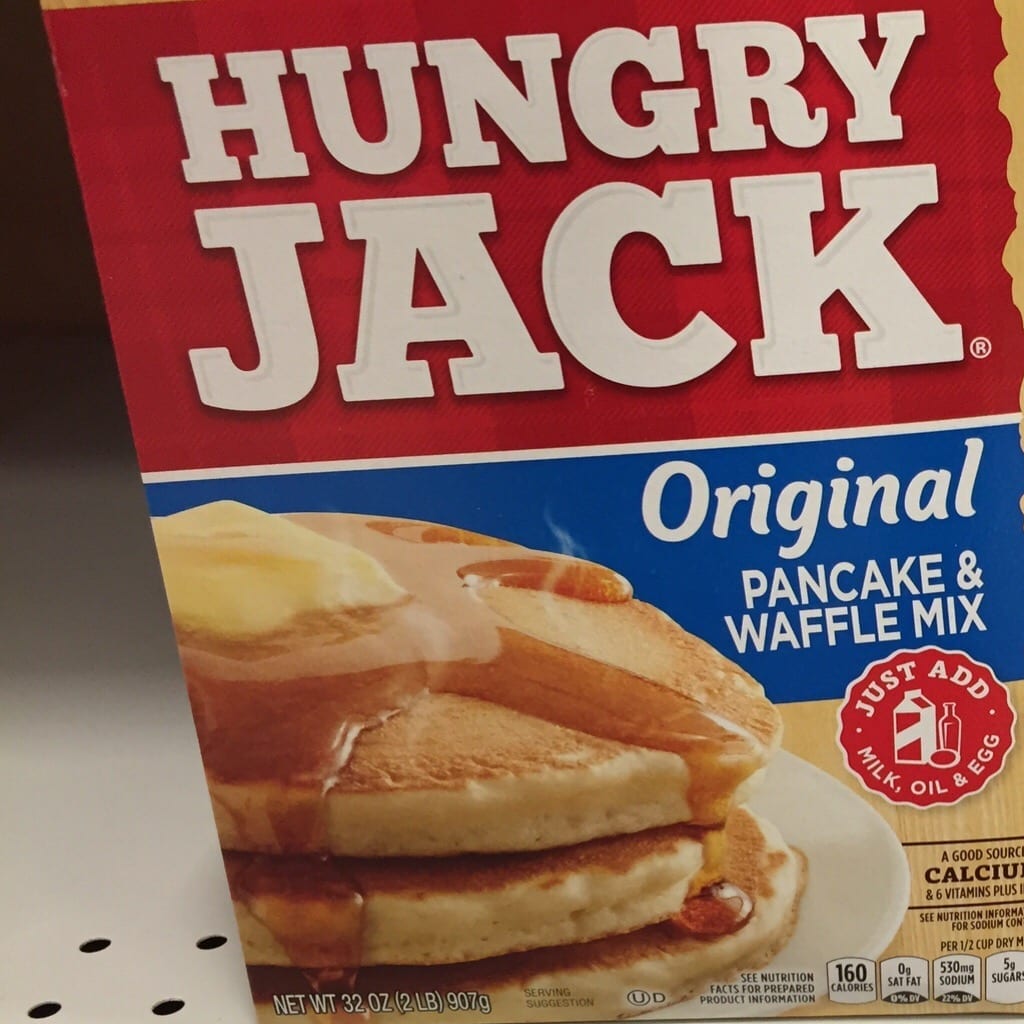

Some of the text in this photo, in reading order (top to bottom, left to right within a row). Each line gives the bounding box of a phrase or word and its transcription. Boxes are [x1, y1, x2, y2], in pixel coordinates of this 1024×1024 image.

[156, 10, 926, 183] HUNGRY
[188, 164, 965, 412] JACK
[642, 438, 984, 559] Original
[742, 550, 984, 608] PANCAKE &
[725, 593, 987, 653] WAFFLE MIX
[856, 660, 990, 717] JUST ADD
[857, 733, 1000, 796] MILK, OIL & EGG
[942, 852, 949, 862] A
[952, 850, 983, 862] GOOD
[926, 890, 933, 900] &
[936, 889, 942, 899] 6
[946, 886, 991, 899] VITAMINS
[994, 884, 1017, 896] PLUS
[898, 963, 911, 977] 0g
[940, 961, 974, 974] 530mg
[1003, 958, 1015, 971] 5g
[836, 964, 866, 982] 160
[888, 976, 921, 986] SAT FAT
[940, 975, 975, 985] SODIUM
[524, 988, 571, 998] SERVING
[831, 983, 874, 992] CALORIES
[272, 991, 492, 1016] NET WT 32 OZ (2 LB) 907g
[526, 998, 594, 1009] SUGGESTION
